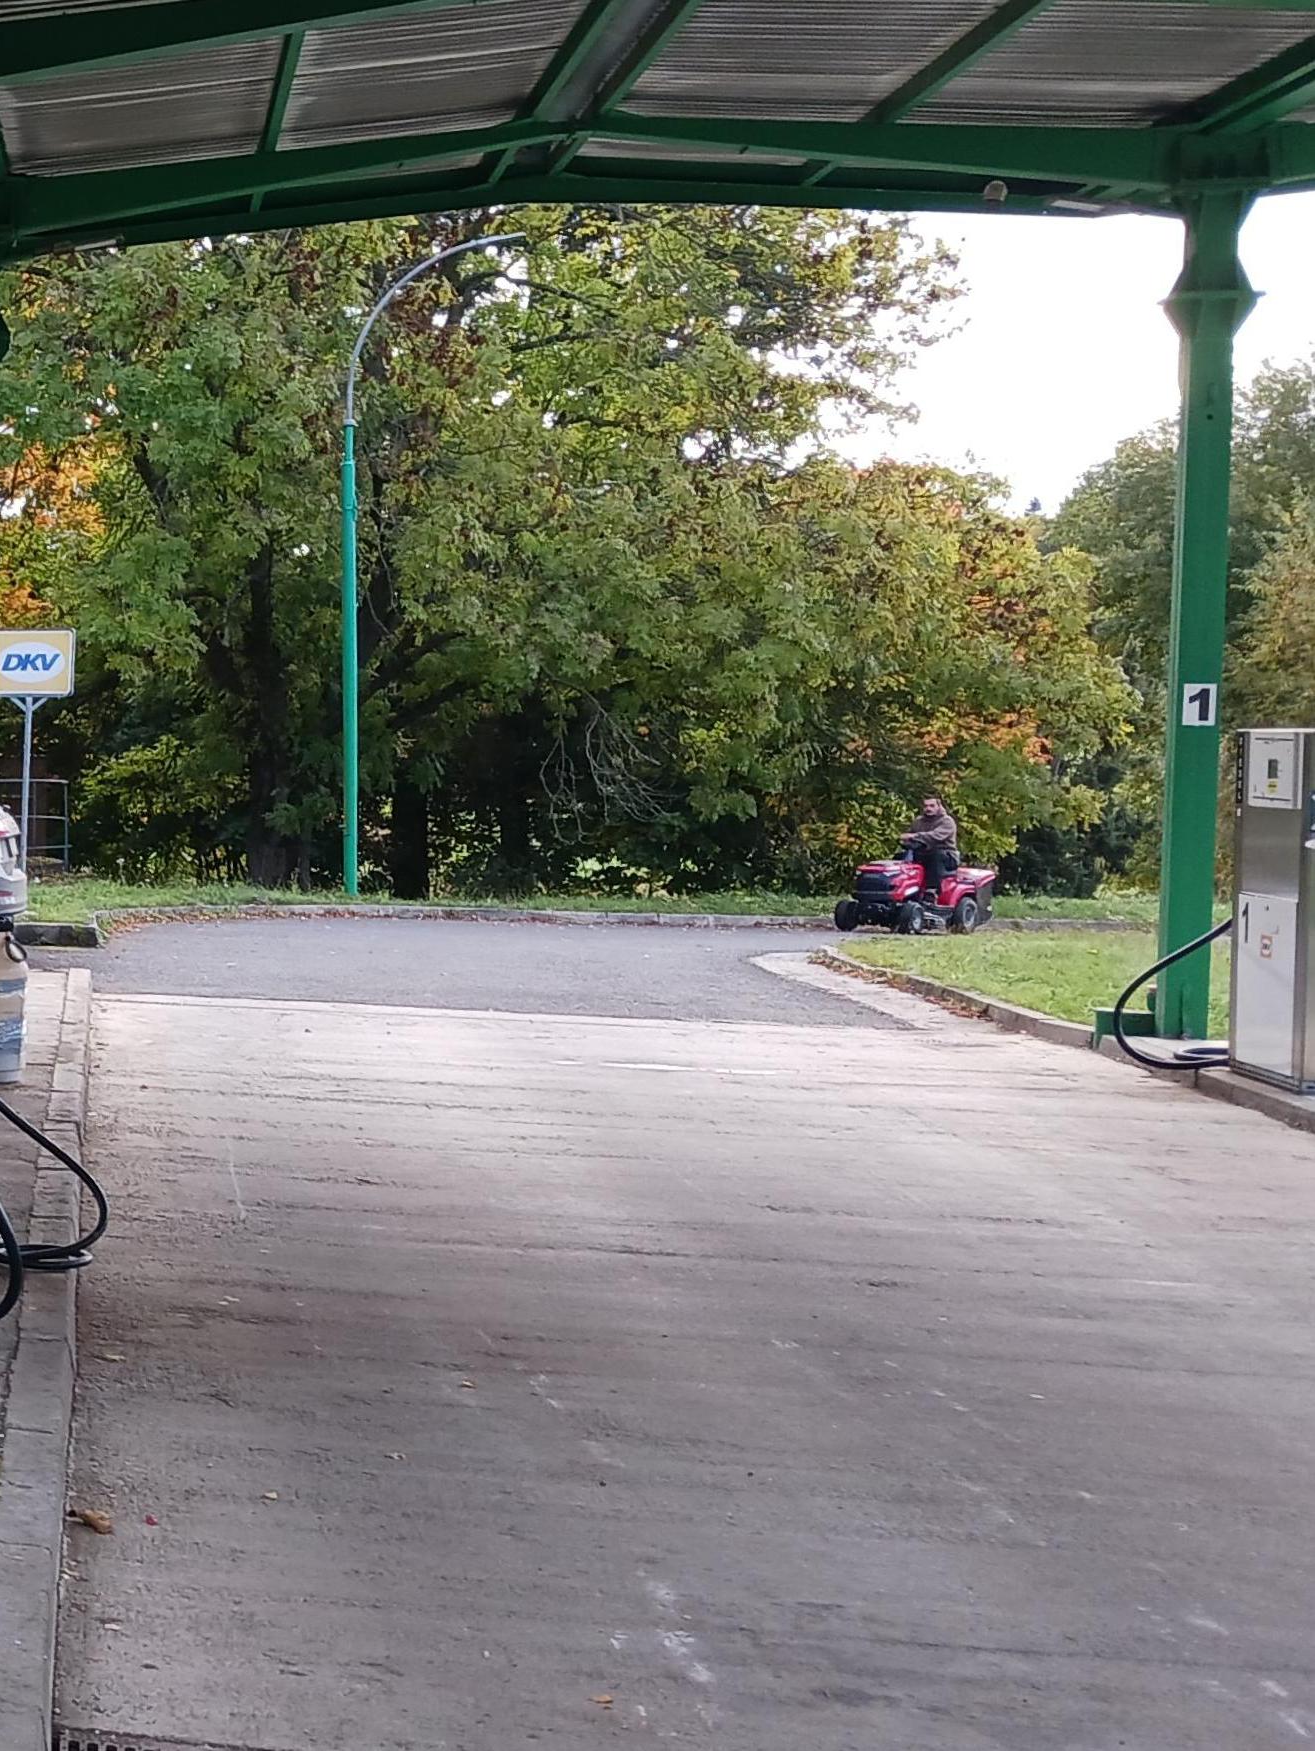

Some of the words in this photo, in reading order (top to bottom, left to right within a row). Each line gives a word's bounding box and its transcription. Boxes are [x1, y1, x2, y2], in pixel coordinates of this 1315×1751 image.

[1, 653, 60, 672] DKV
[1188, 687, 1212, 722] 1
[1241, 902, 1249, 943] 1
